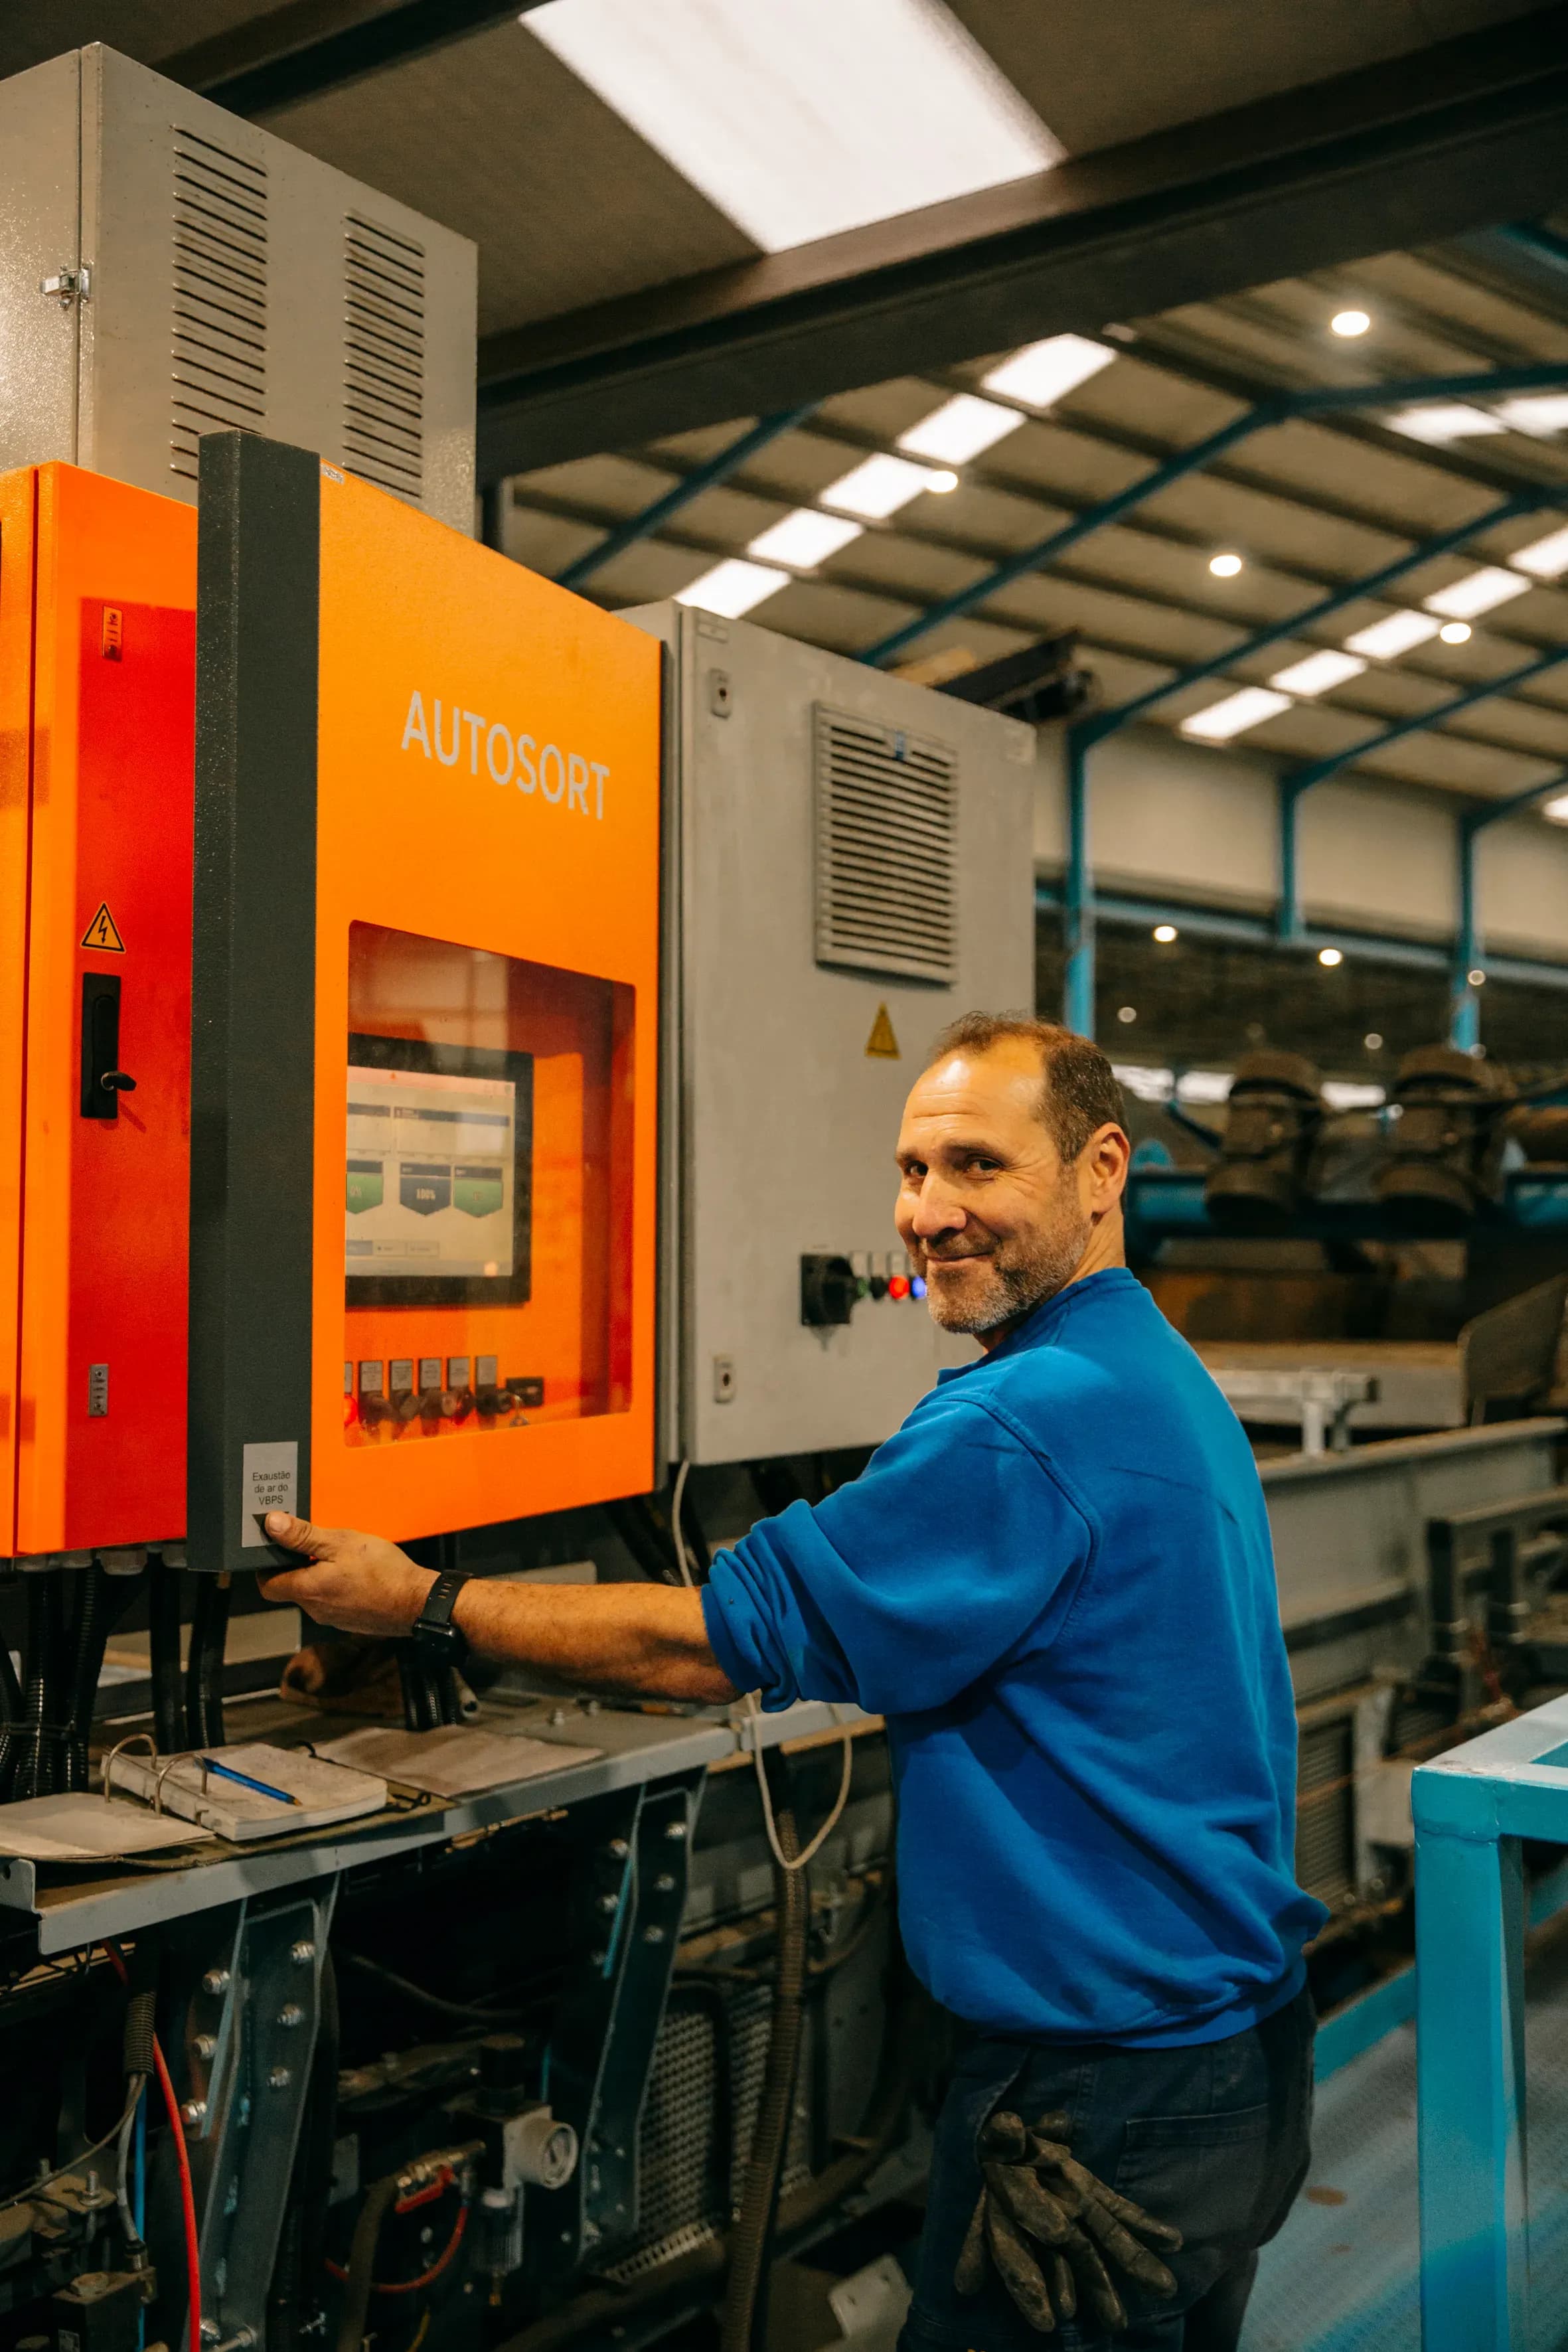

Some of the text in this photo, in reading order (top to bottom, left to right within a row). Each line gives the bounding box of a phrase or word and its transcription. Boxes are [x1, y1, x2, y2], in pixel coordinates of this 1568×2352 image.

[401, 690, 610, 821] AUTOSORT
[252, 1470, 291, 1481] Exaustão
[254, 1484, 265, 1493] de
[277, 1483, 288, 1492] do
[259, 1495, 283, 1505] VBPS
